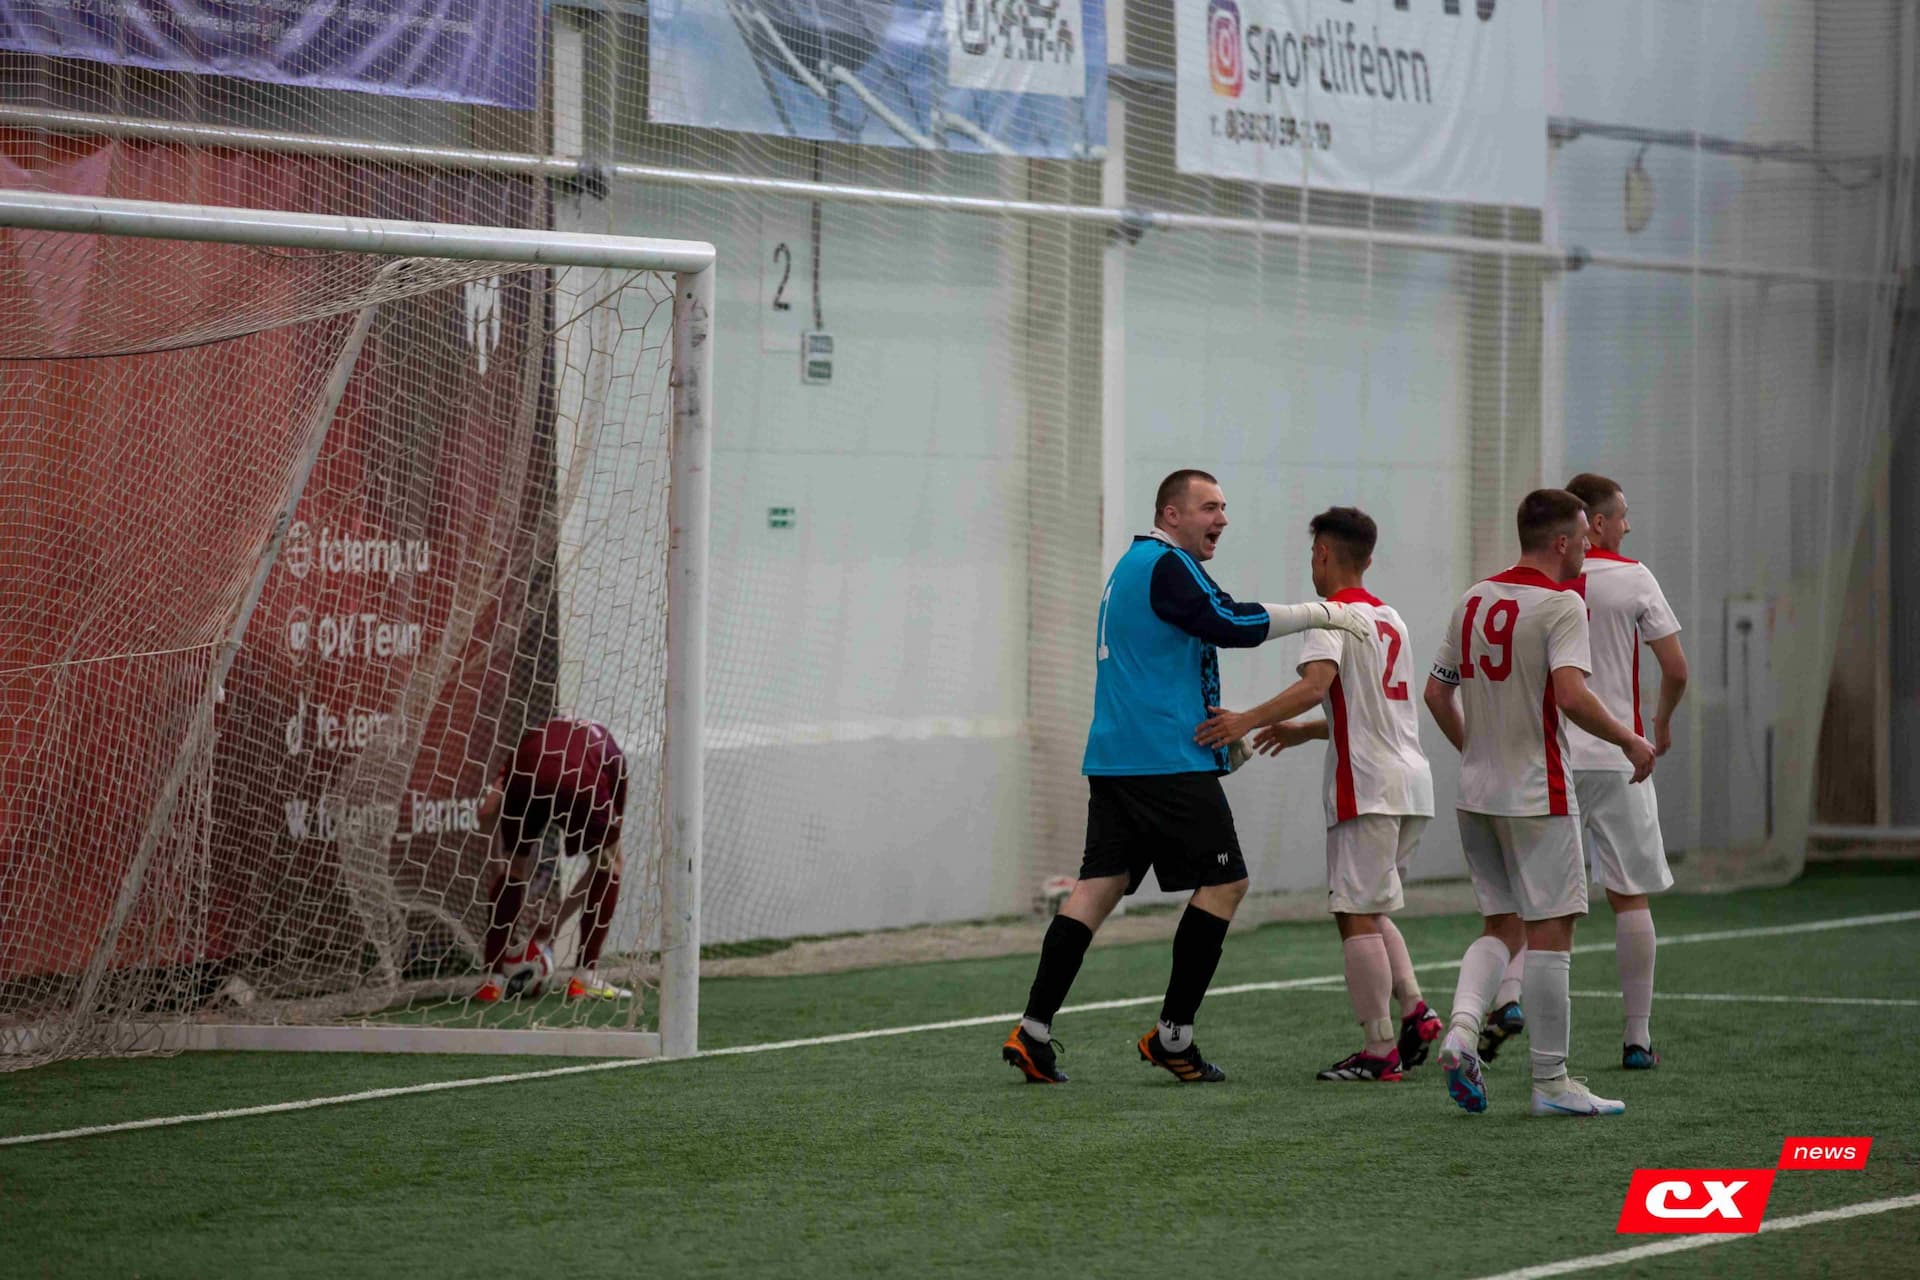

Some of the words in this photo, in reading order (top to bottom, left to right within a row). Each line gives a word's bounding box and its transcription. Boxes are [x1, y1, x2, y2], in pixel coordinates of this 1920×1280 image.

[772, 242, 791, 311] 2
[1098, 579, 1115, 661] 1
[1374, 619, 1409, 701] 2
[1459, 595, 1520, 682] 19
